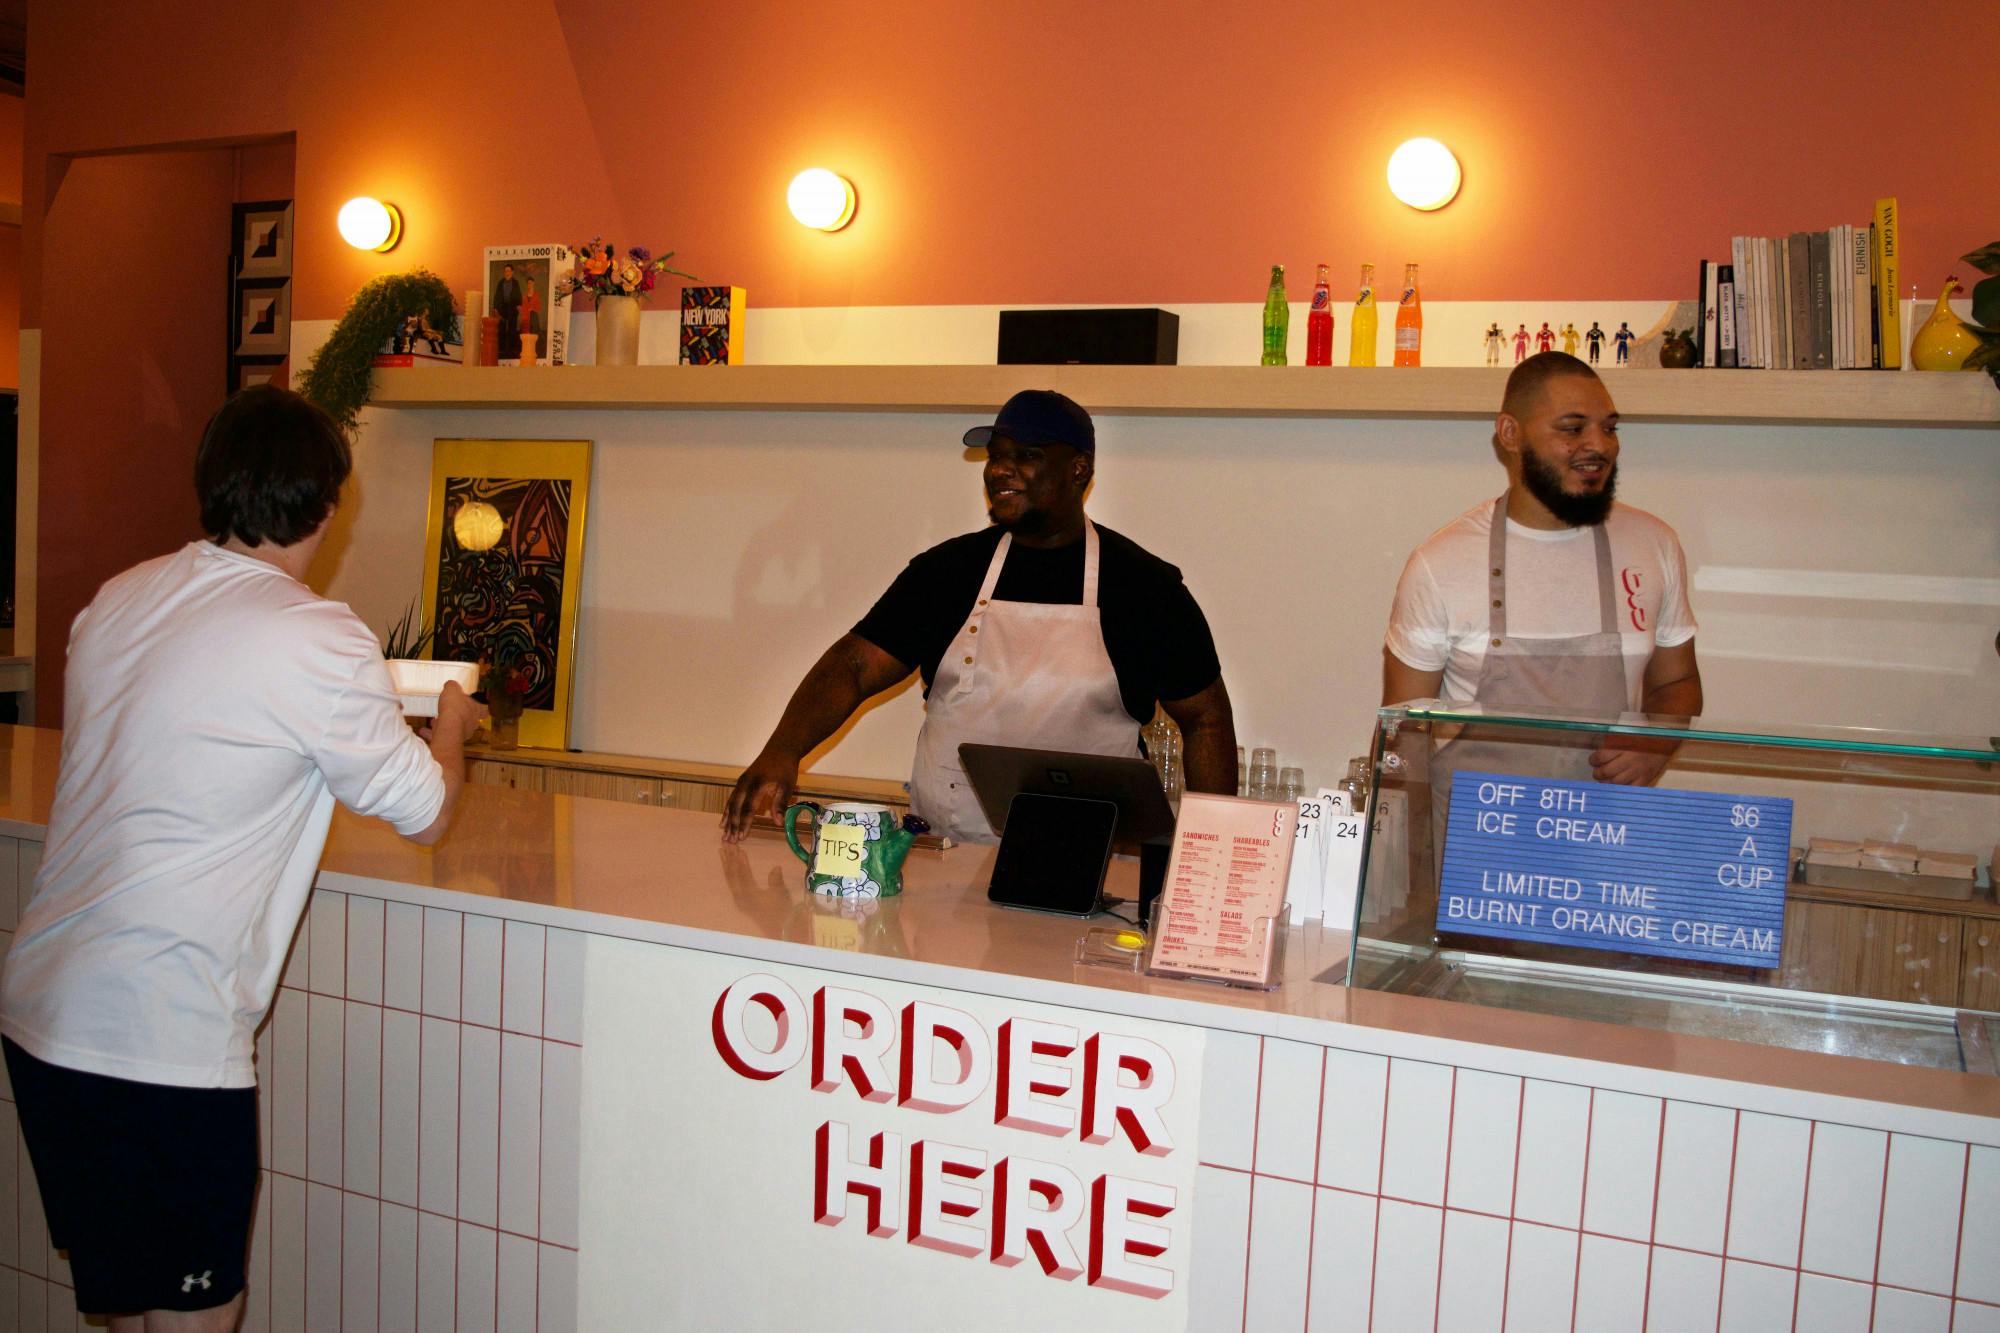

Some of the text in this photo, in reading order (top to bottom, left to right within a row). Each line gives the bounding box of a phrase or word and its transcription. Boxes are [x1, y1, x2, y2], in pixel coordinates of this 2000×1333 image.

[532, 247, 551, 256] 1000
[1856, 232, 1866, 275] FURNISH
[684, 308, 727, 326] NEW YORK
[1478, 782, 1586, 813] OFF 8TH
[1301, 803, 1321, 818] 23
[1730, 804, 1760, 828] $6
[1182, 831, 1219, 842] SANDWICHES
[1337, 822, 1357, 838] 24
[1477, 811, 1626, 846] ICE CREAM
[822, 839, 860, 861] TIPS
[1739, 835, 1758, 858] A
[1717, 863, 1773, 889] CUP
[1482, 870, 1657, 910] LIMITED TIME
[1220, 910, 1243, 920] SALADS
[1448, 897, 1774, 952] BURNT ORANGE CREAM
[712, 972, 1177, 1158] ORDER
[813, 1120, 1177, 1300] HERE
